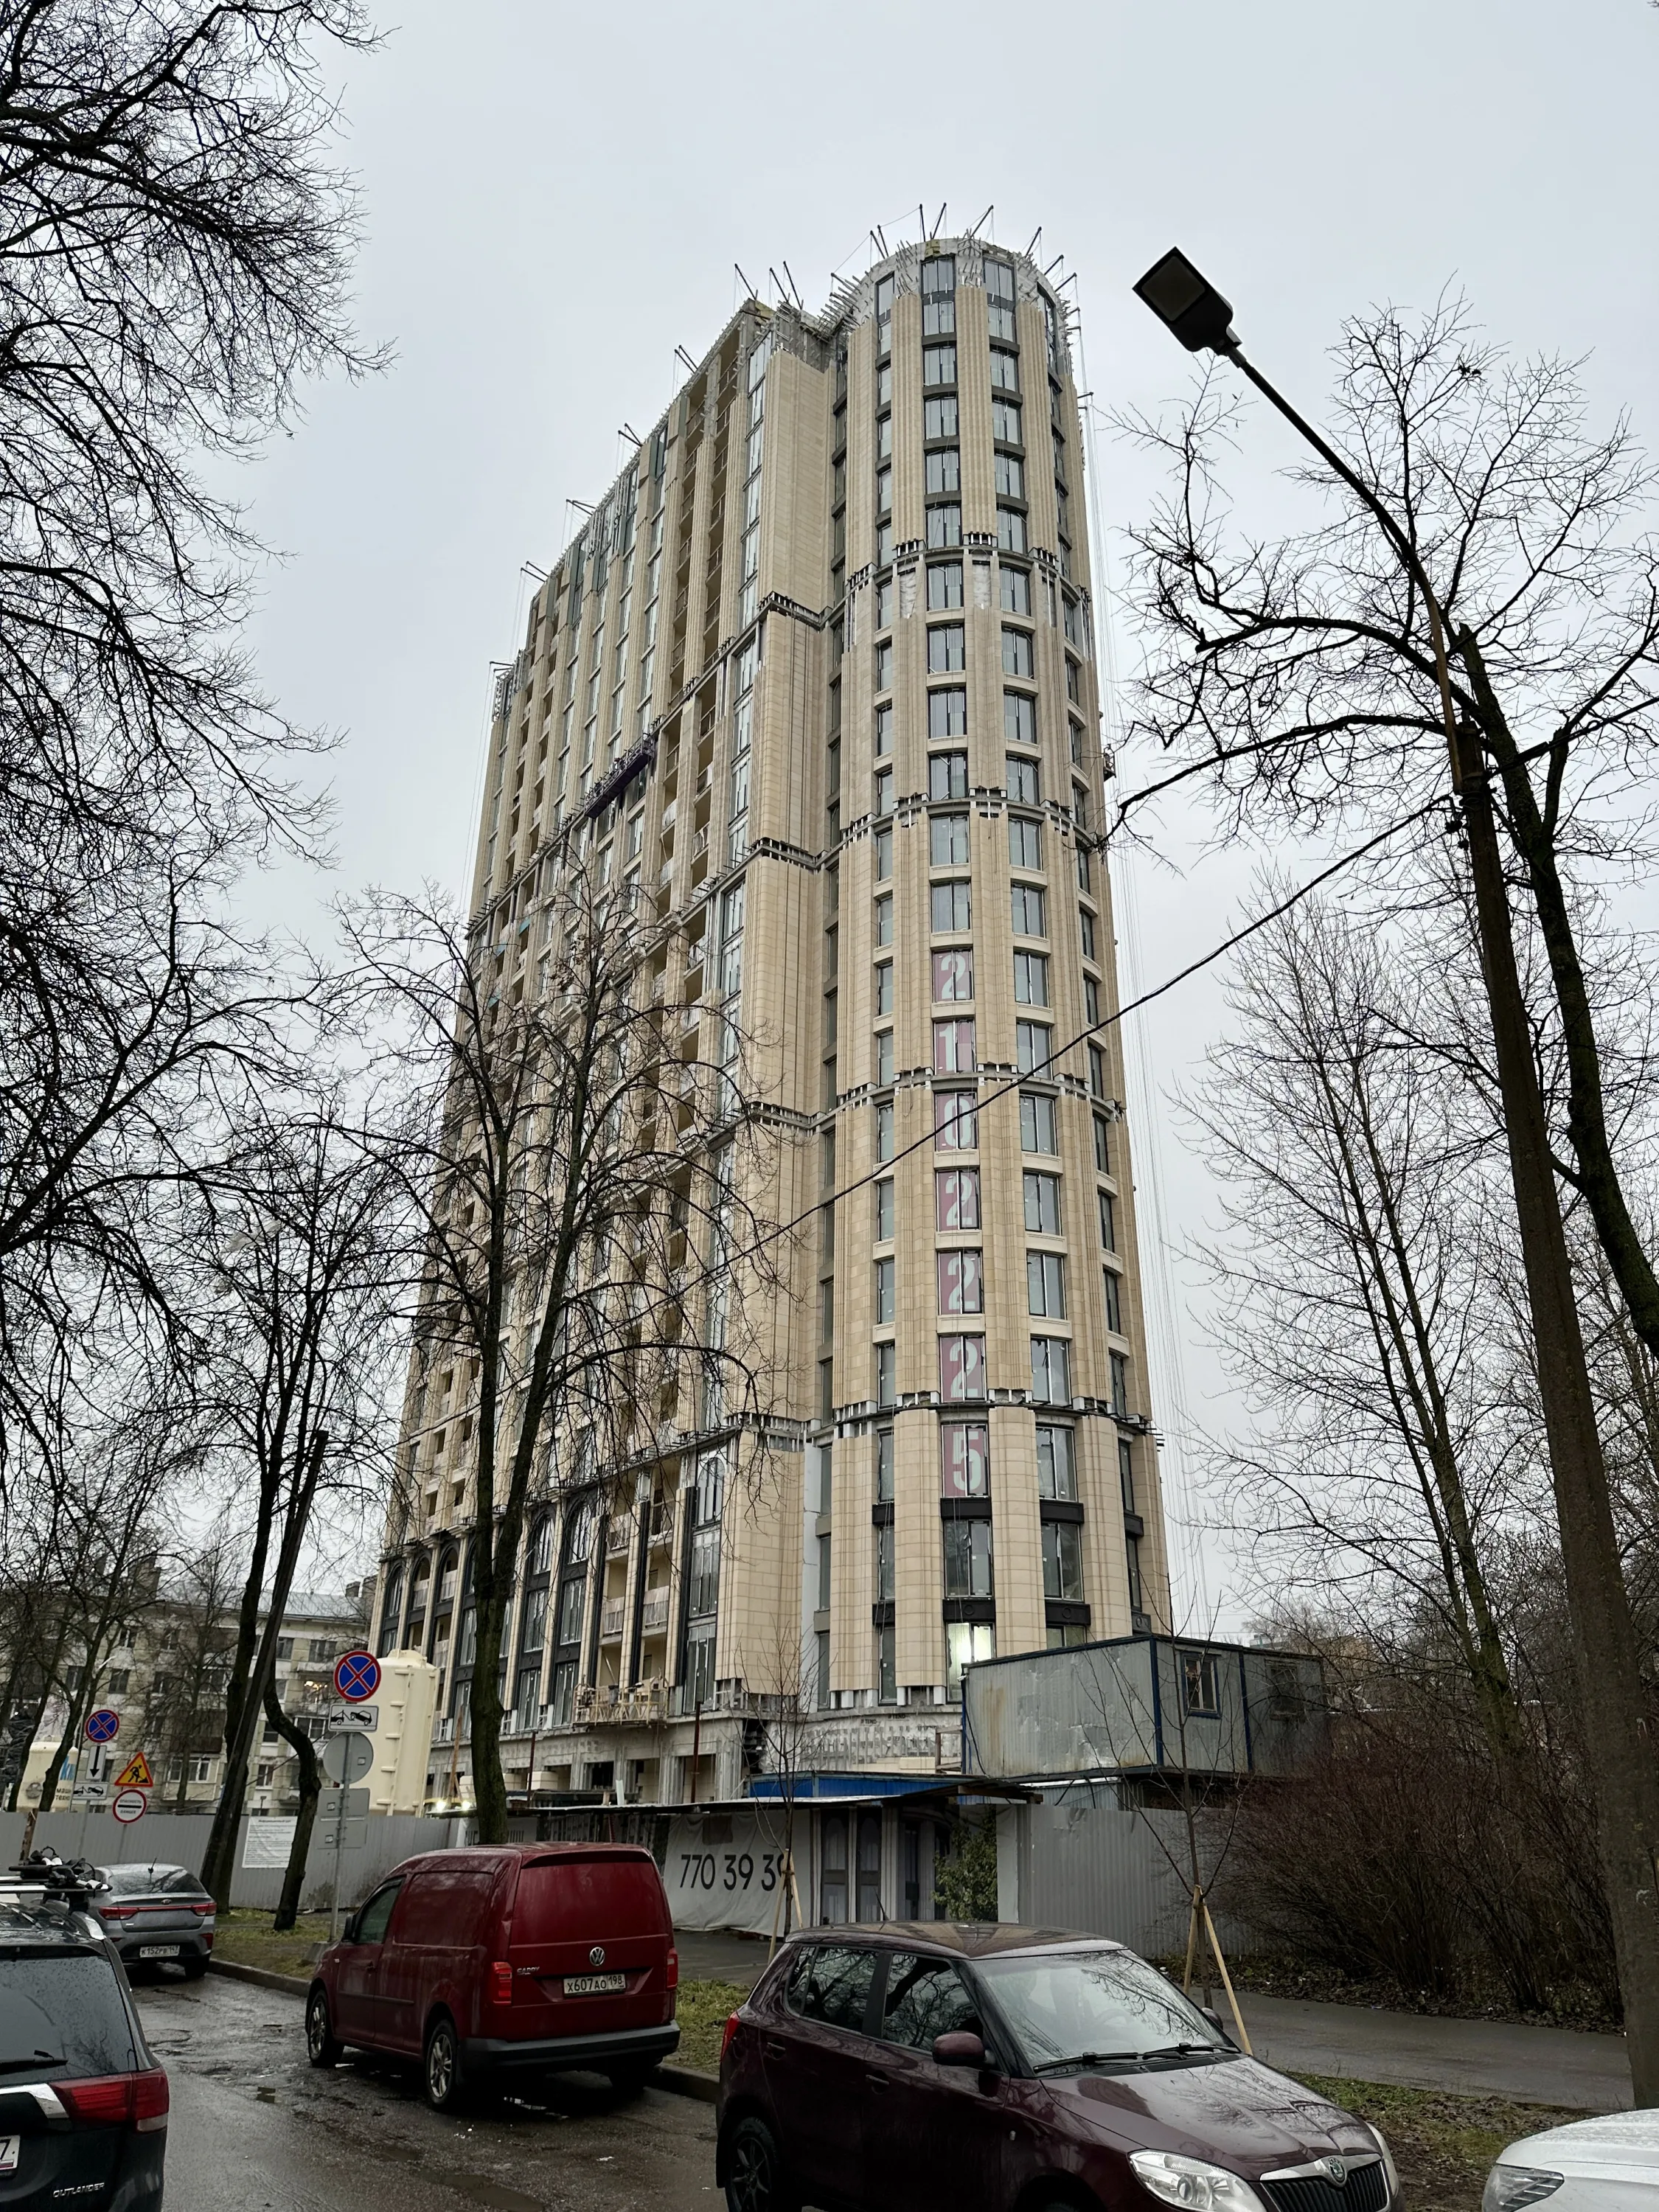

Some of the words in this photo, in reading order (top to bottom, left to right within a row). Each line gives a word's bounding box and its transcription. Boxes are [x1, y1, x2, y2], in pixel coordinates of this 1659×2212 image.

[680, 1854, 716, 1890] 770
[723, 1854, 754, 1891] 39
[608, 1975, 622, 1986] 198
[53, 2183, 105, 2197] OUTLANDER
